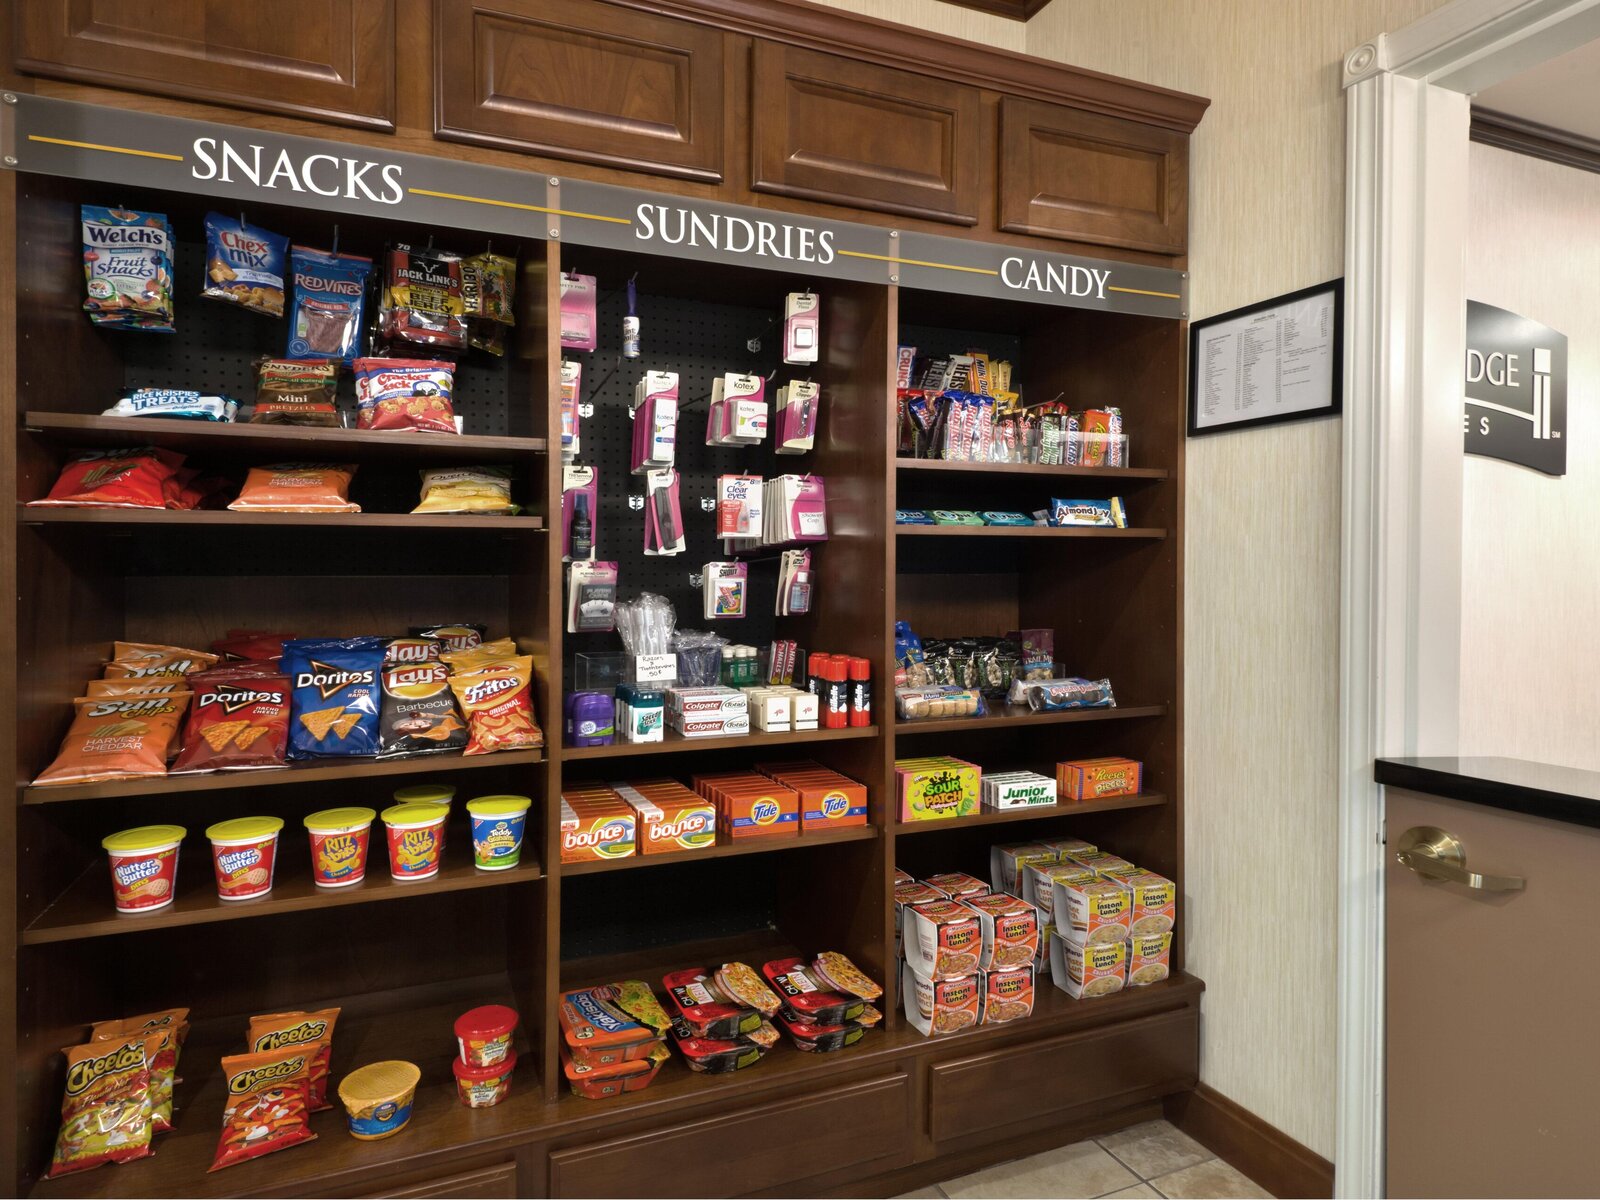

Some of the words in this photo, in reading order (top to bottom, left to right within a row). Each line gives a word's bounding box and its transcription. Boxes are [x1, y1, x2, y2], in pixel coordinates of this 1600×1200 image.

[192, 137, 404, 205] SNACKS
[87, 226, 163, 245] Welch's
[635, 203, 835, 265] SUNDRIES
[220, 231, 270, 254] Chex
[108, 257, 147, 267] Fruit
[96, 263, 154, 277] Snacks
[398, 268, 423, 281] JACK
[1000, 257, 1112, 300] CANDY
[463, 266, 479, 310] HARIBO
[404, 299, 454, 313] JERKY
[411, 292, 449, 305] BEEF
[897, 349, 912, 388] CRUNC
[925, 361, 949, 389] HERS
[976, 359, 986, 377] Milk
[1466, 348, 1520, 388] DGE
[377, 373, 432, 386] Cracker
[949, 364, 971, 389] HERS
[378, 381, 411, 394] Jack
[979, 379, 989, 396] Dud
[132, 392, 154, 401] RICE
[155, 390, 199, 398] KRISPIES
[277, 395, 308, 403] Mini
[134, 396, 200, 411] TREATS
[1067, 420, 1079, 464] SNICKERS
[726, 485, 748, 493] Clear
[727, 492, 747, 500] eyes
[1057, 507, 1093, 518] Almond
[775, 651, 786, 674] HALLS
[786, 648, 798, 674] HALLS
[296, 670, 374, 689] Doritos
[464, 676, 519, 705] Fritos
[199, 690, 283, 707] Doritos
[86, 697, 172, 718] Sun
[120, 704, 175, 719] Chips
[489, 699, 521, 716] ORIGINAL
[686, 702, 720, 711] Colgate
[687, 722, 722, 731] Colgate
[82, 742, 143, 752] CHEDDAR
[85, 735, 145, 746] HARVEST
[1096, 768, 1126, 780] Reese's
[926, 780, 960, 795] SOUR
[1002, 786, 1048, 800] Junior
[824, 798, 847, 814] Tide
[925, 790, 962, 807] PATCH
[1027, 795, 1055, 806] Mints
[754, 804, 778, 821] Tide
[490, 829, 512, 837] Teddy
[650, 817, 706, 840] bounce
[324, 836, 353, 852] RITZ
[403, 829, 431, 845] RITZ
[565, 827, 623, 848] bounce
[219, 849, 256, 867] Nutter
[224, 855, 258, 874] Butter
[116, 859, 155, 877] Nutter
[121, 865, 160, 887] Butter
[1142, 893, 1168, 901] Instant
[1145, 899, 1166, 907] Lunch
[1096, 900, 1123, 910] Instant
[1099, 907, 1121, 916] Lunch
[945, 930, 974, 941] Instant
[1002, 923, 1030, 933] Instant
[1005, 930, 1028, 939] Lunch
[948, 938, 971, 947] Lunch
[1141, 942, 1164, 952] Instant
[1092, 953, 1118, 963] Instant
[1143, 949, 1161, 957] Lunch
[1095, 959, 1116, 968] Lunch
[995, 978, 1025, 988] Instant
[998, 985, 1022, 994] Lunch
[943, 987, 971, 998] Instant
[945, 994, 968, 1003] Lunch
[254, 1021, 327, 1053] Cheetos
[67, 1044, 145, 1094] Cheetos
[230, 1056, 305, 1094] Cheetos
